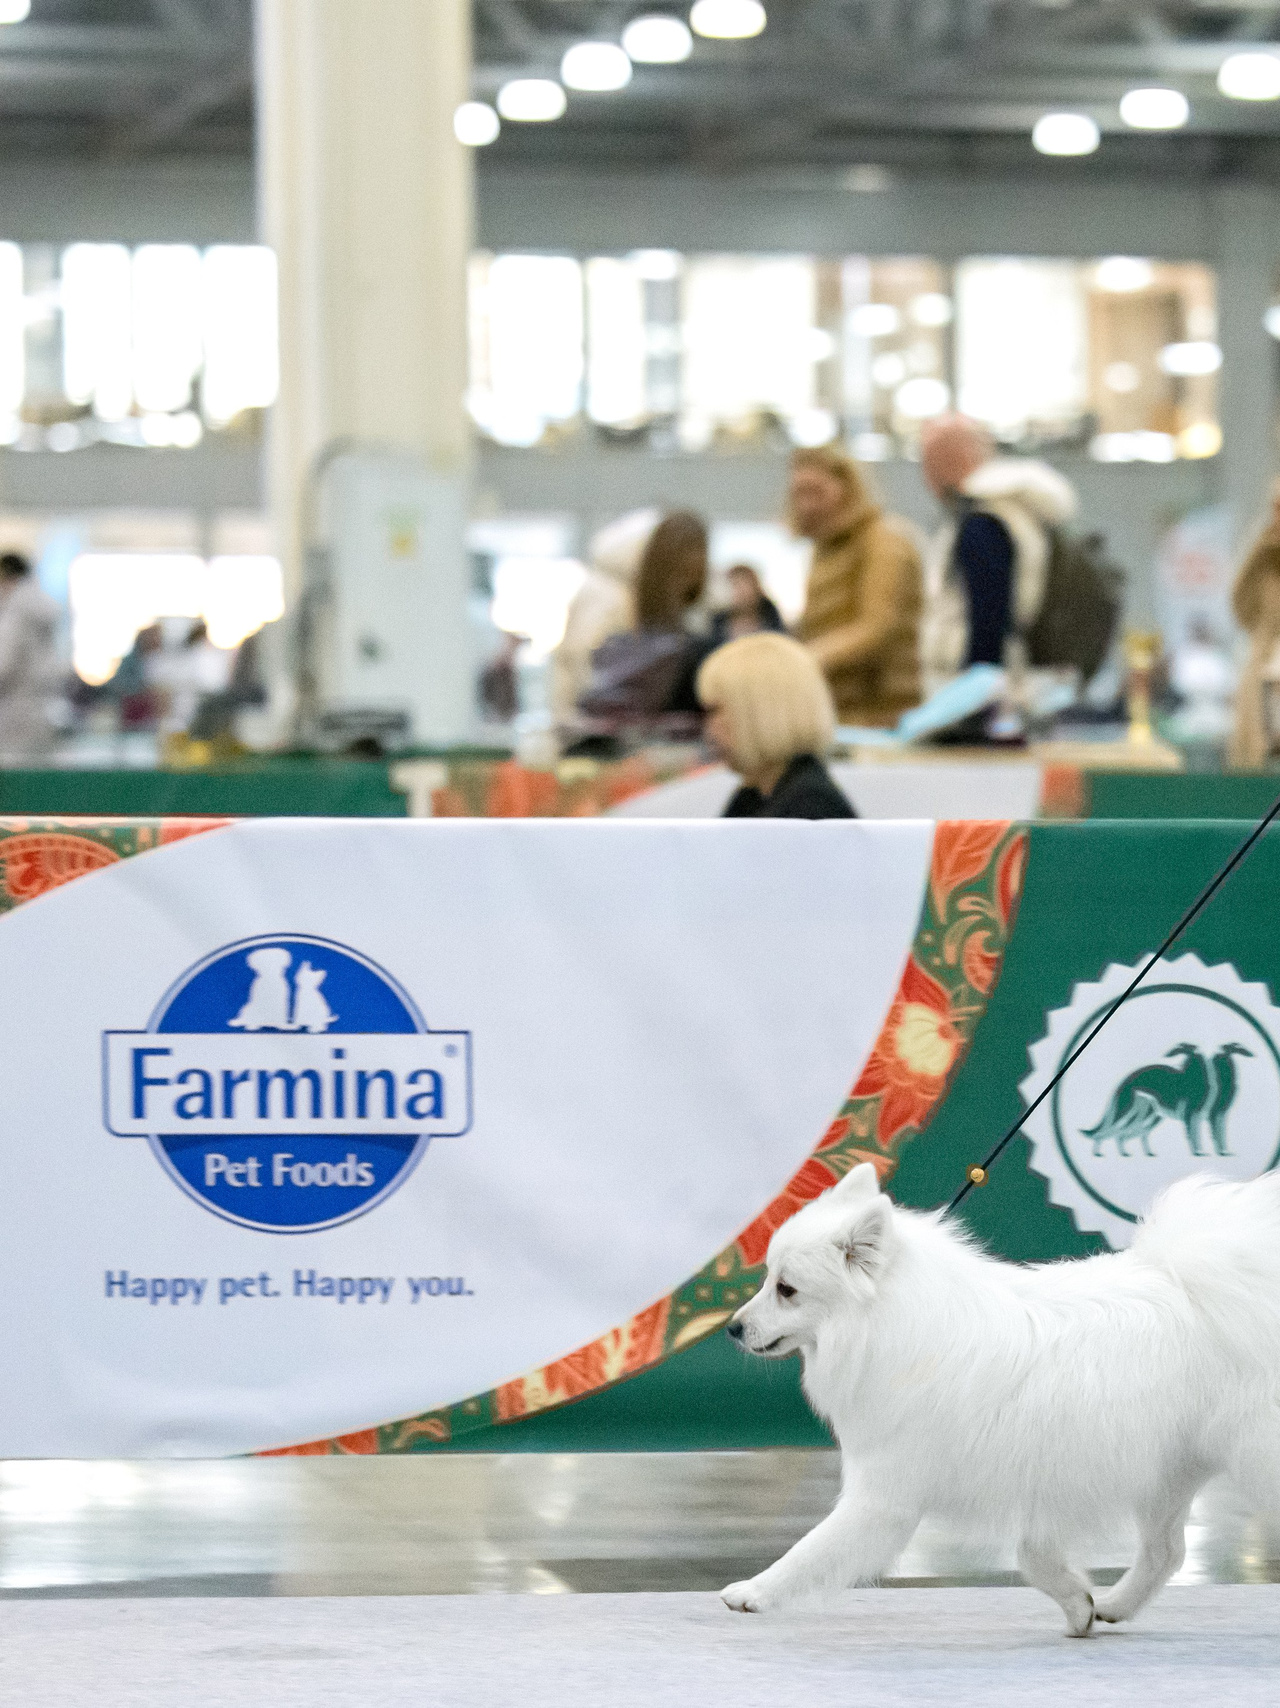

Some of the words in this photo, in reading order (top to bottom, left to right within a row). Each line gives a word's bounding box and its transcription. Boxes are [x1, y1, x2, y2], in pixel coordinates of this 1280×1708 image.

[204, 1153, 262, 1188] Pet
[272, 1152, 376, 1188] Foods
[104, 1269, 207, 1305] Happy
[217, 1272, 281, 1305] pet.
[292, 1269, 396, 1305] Happy
[406, 1275, 475, 1304] you.
